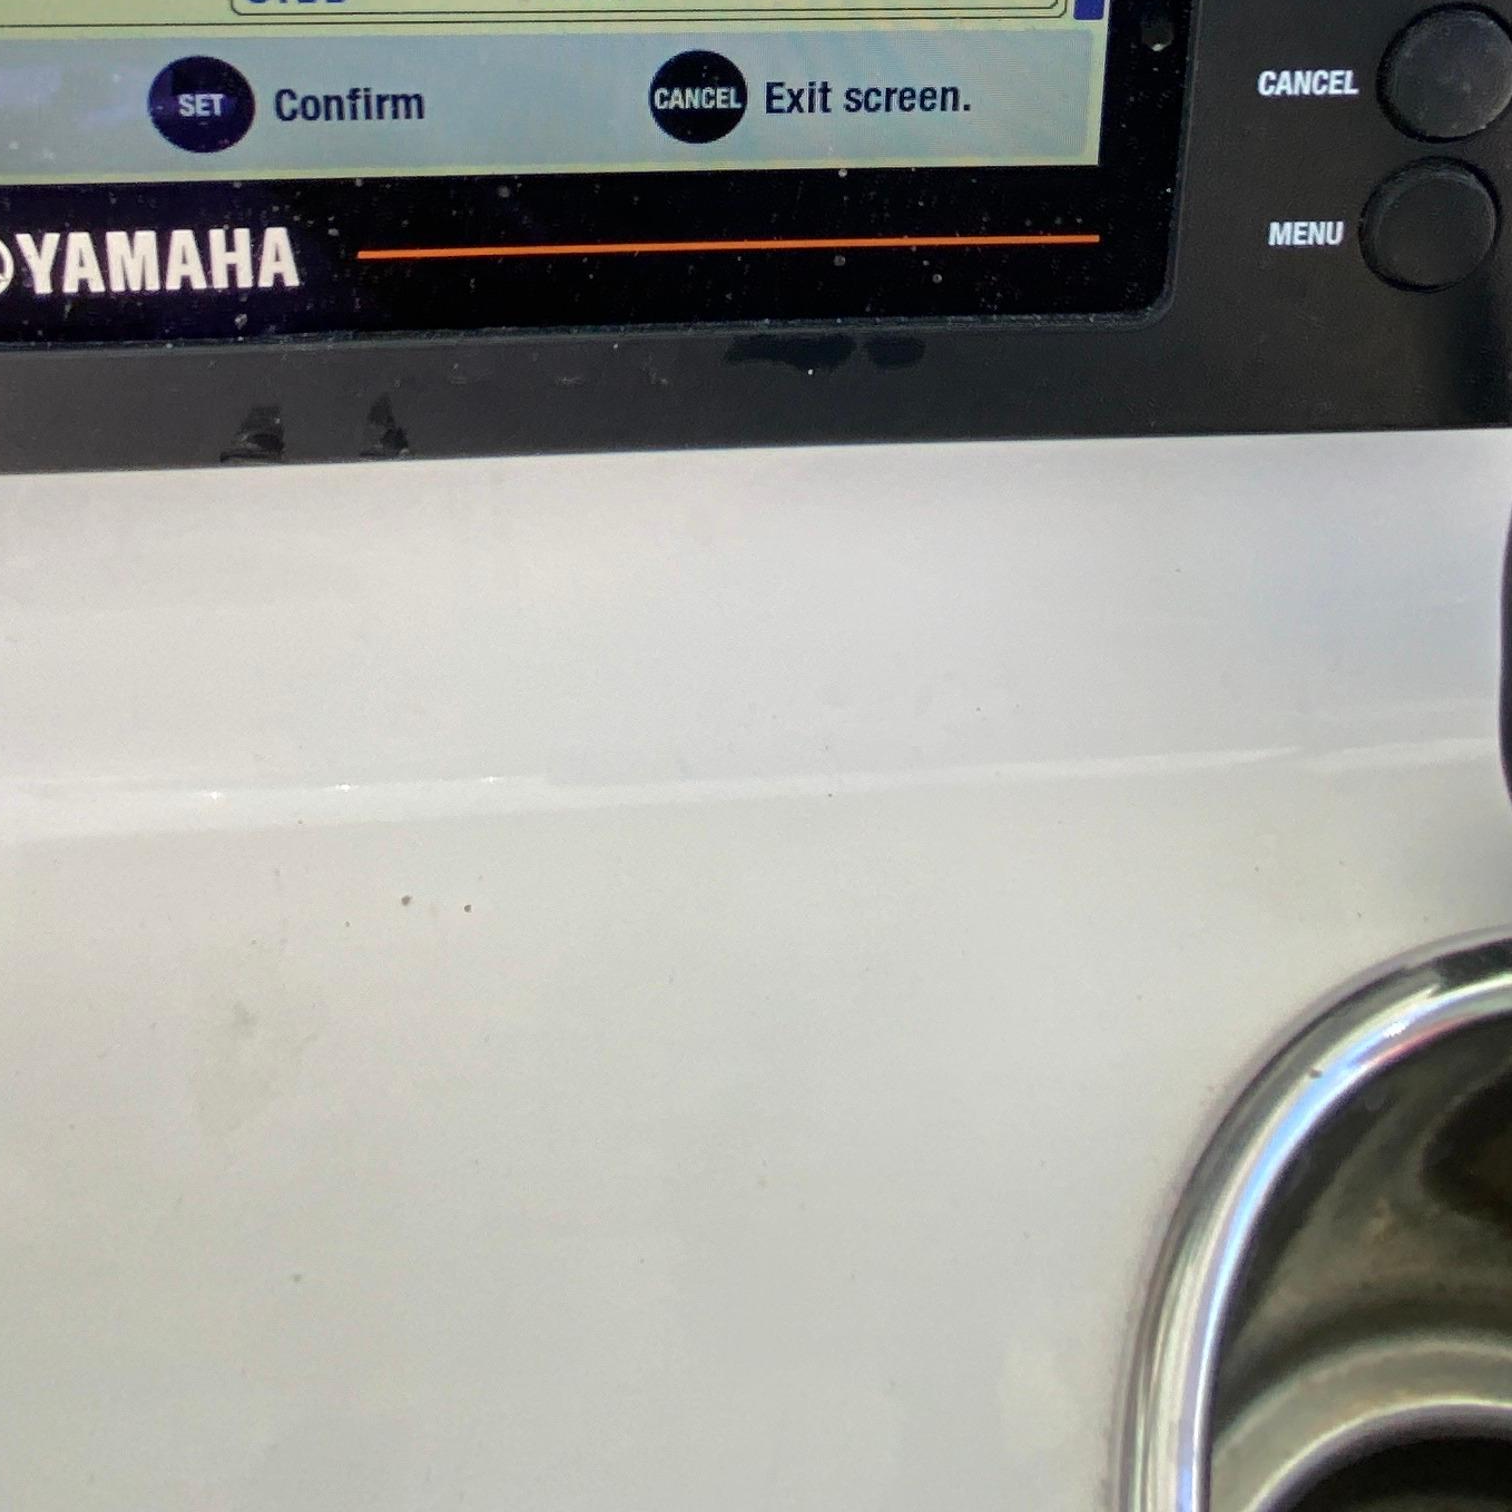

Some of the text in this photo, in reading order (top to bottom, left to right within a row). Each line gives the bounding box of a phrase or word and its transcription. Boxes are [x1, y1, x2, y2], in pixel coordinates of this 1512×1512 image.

[653, 87, 743, 110] CANCEL
[765, 80, 972, 115] Exit screen.
[1257, 71, 1359, 99] CANCEL
[177, 93, 225, 118] SET
[274, 88, 426, 122] Confirm
[1267, 221, 1345, 248] MENU
[15, 225, 300, 295] YAMAHA
